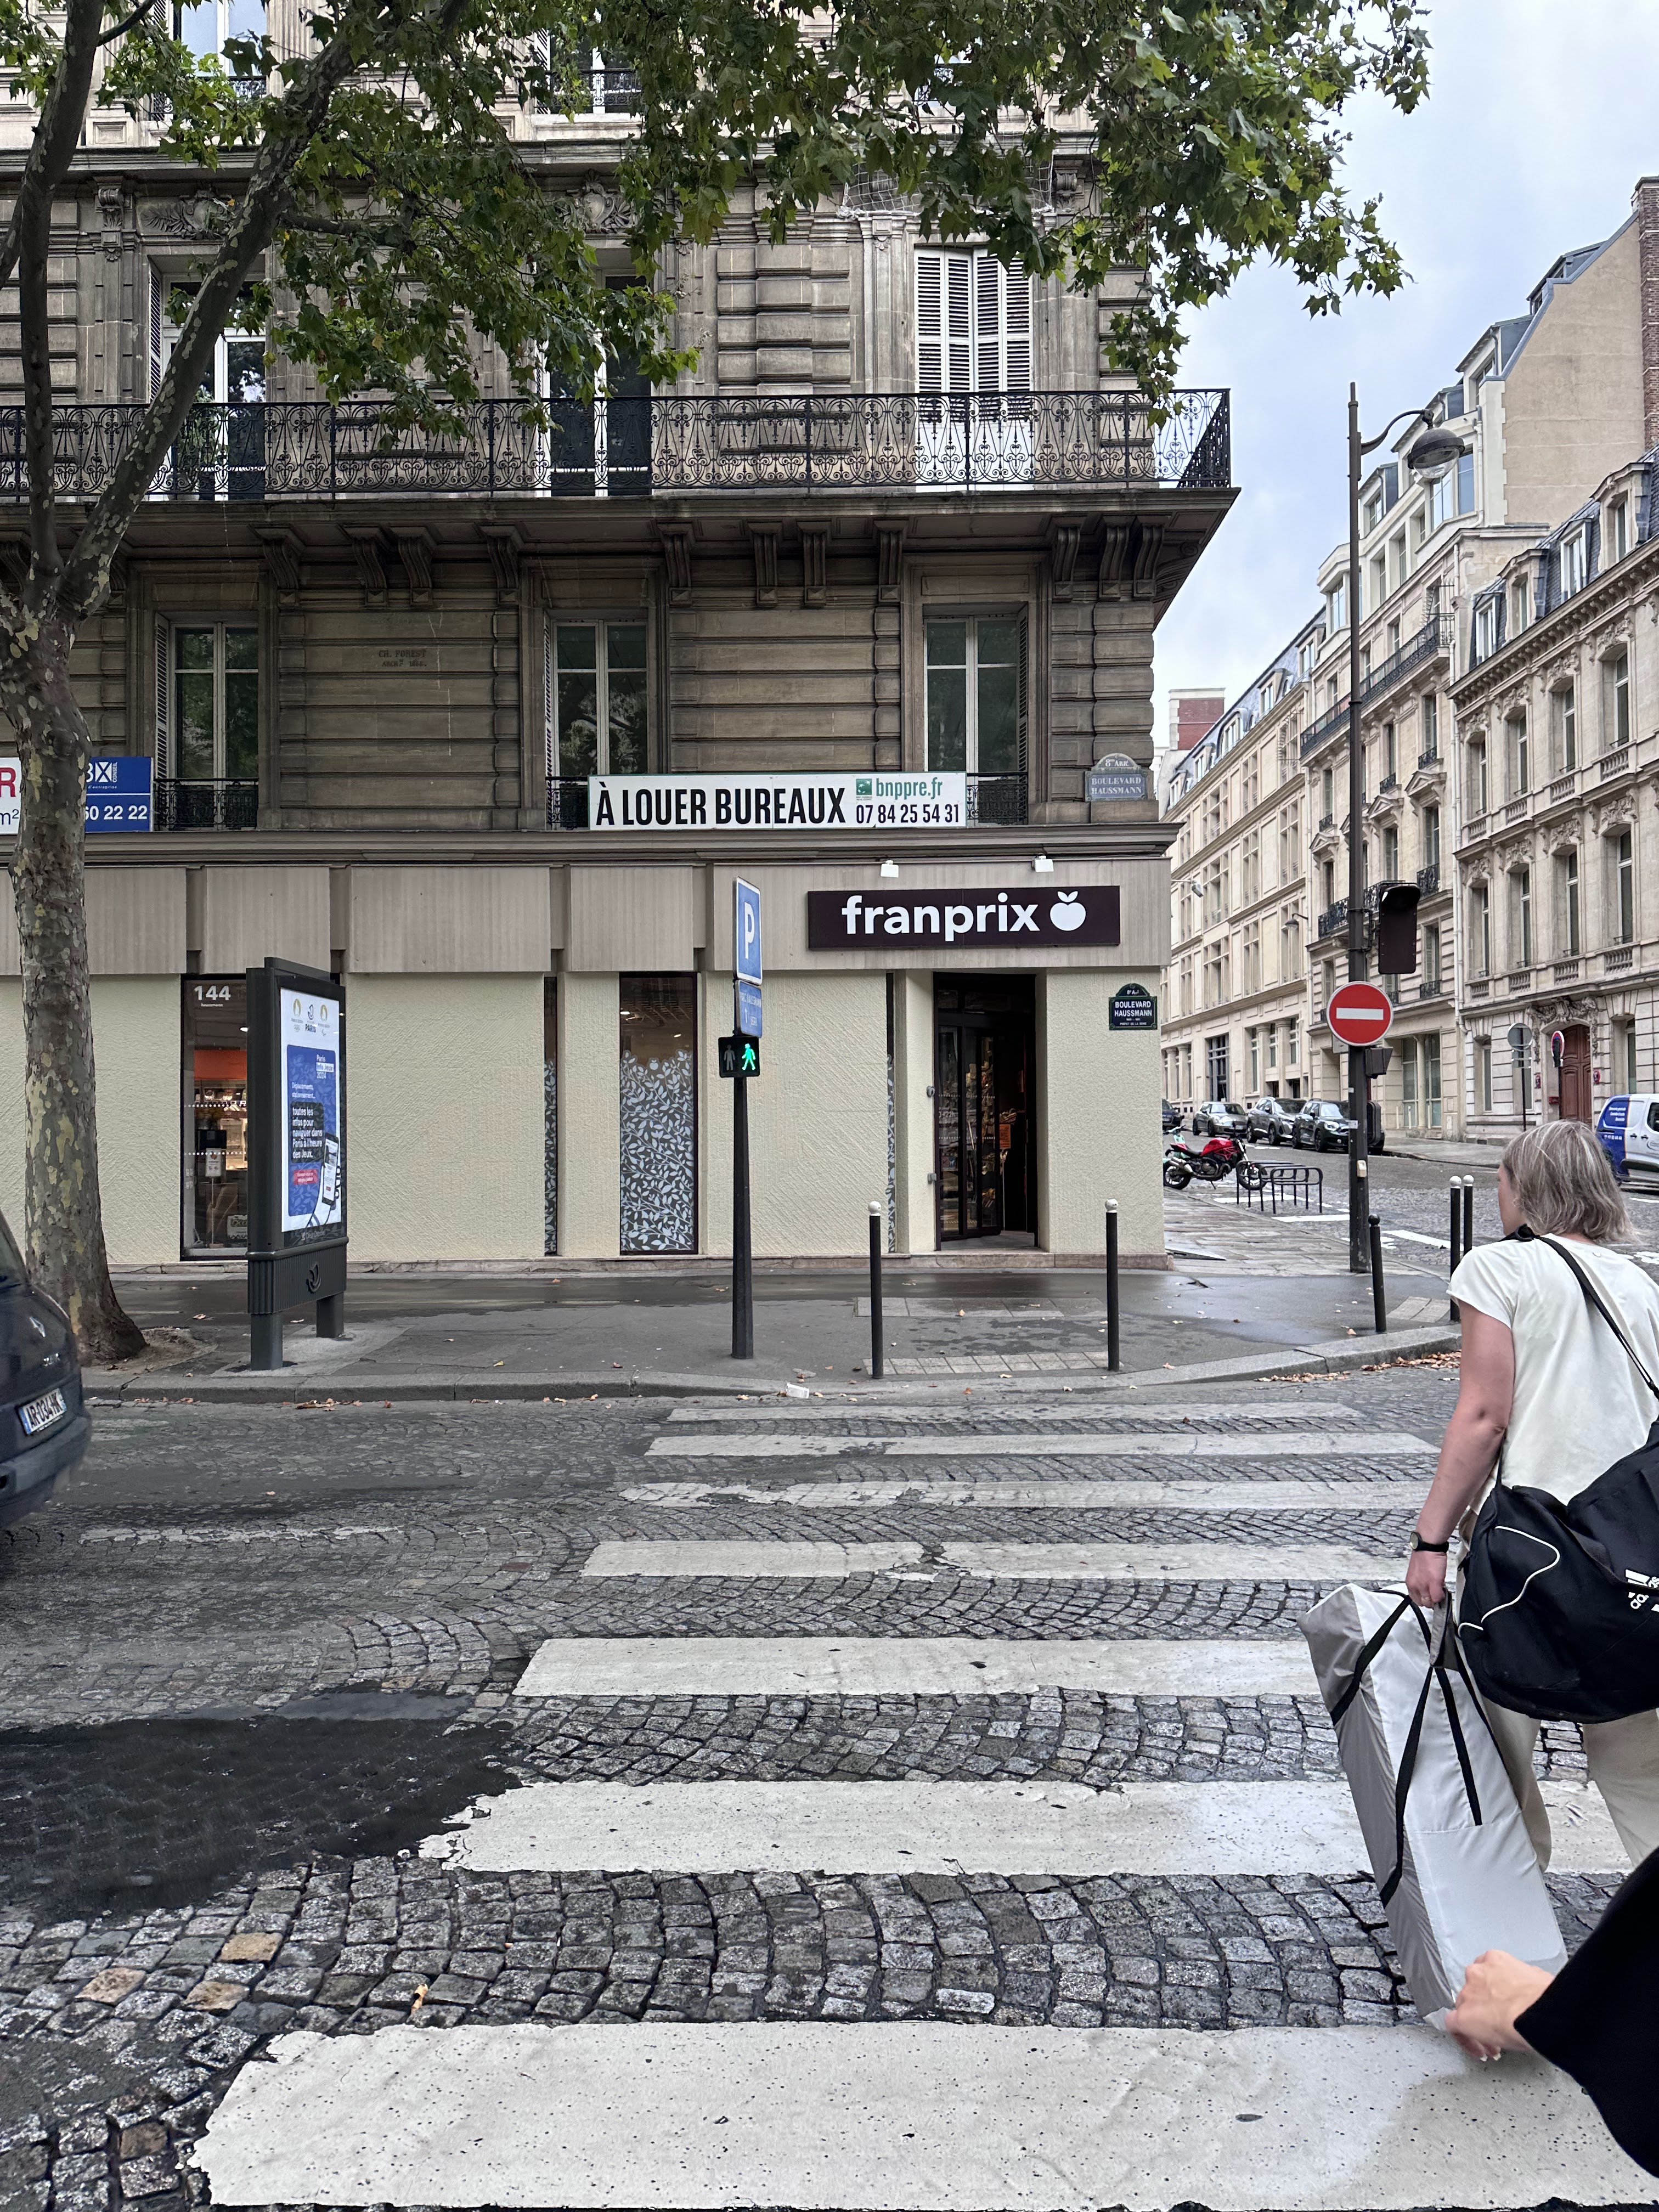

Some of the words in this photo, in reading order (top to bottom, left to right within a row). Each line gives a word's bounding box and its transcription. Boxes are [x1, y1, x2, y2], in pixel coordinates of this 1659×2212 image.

[1091, 777, 1142, 785] BOULEVARD
[876, 777, 943, 800] bnppre.fr
[596, 781, 615, 825] À
[623, 789, 706, 825] LOUER
[715, 788, 846, 825] BUREAUX
[104, 805, 123, 820] 22
[128, 805, 148, 820] 22
[856, 804, 873, 823] 07
[878, 804, 895, 823] 84
[900, 804, 917, 823] 25
[923, 804, 940, 823] 54
[945, 804, 959, 823] 31
[841, 892, 1040, 942] franprix
[744, 901, 755, 960] P
[194, 985, 231, 1001] 144
[305, 1024, 317, 1033] PARIS
[316, 1054, 326, 1062] Paris
[292, 1107, 306, 1116] toutes
[292, 1117, 303, 1126] infos
[303, 1118, 314, 1129] pour
[292, 1127, 311, 1140] naviguer
[312, 1127, 323, 1137] dans
[292, 1138, 303, 1148] Paris
[303, 1139, 307, 1148] à
[307, 1138, 323, 1148] l'heure
[292, 1149, 301, 1159] des
[301, 1149, 313, 1158] Jeux.
[1630, 1576, 1659, 1610] adas
